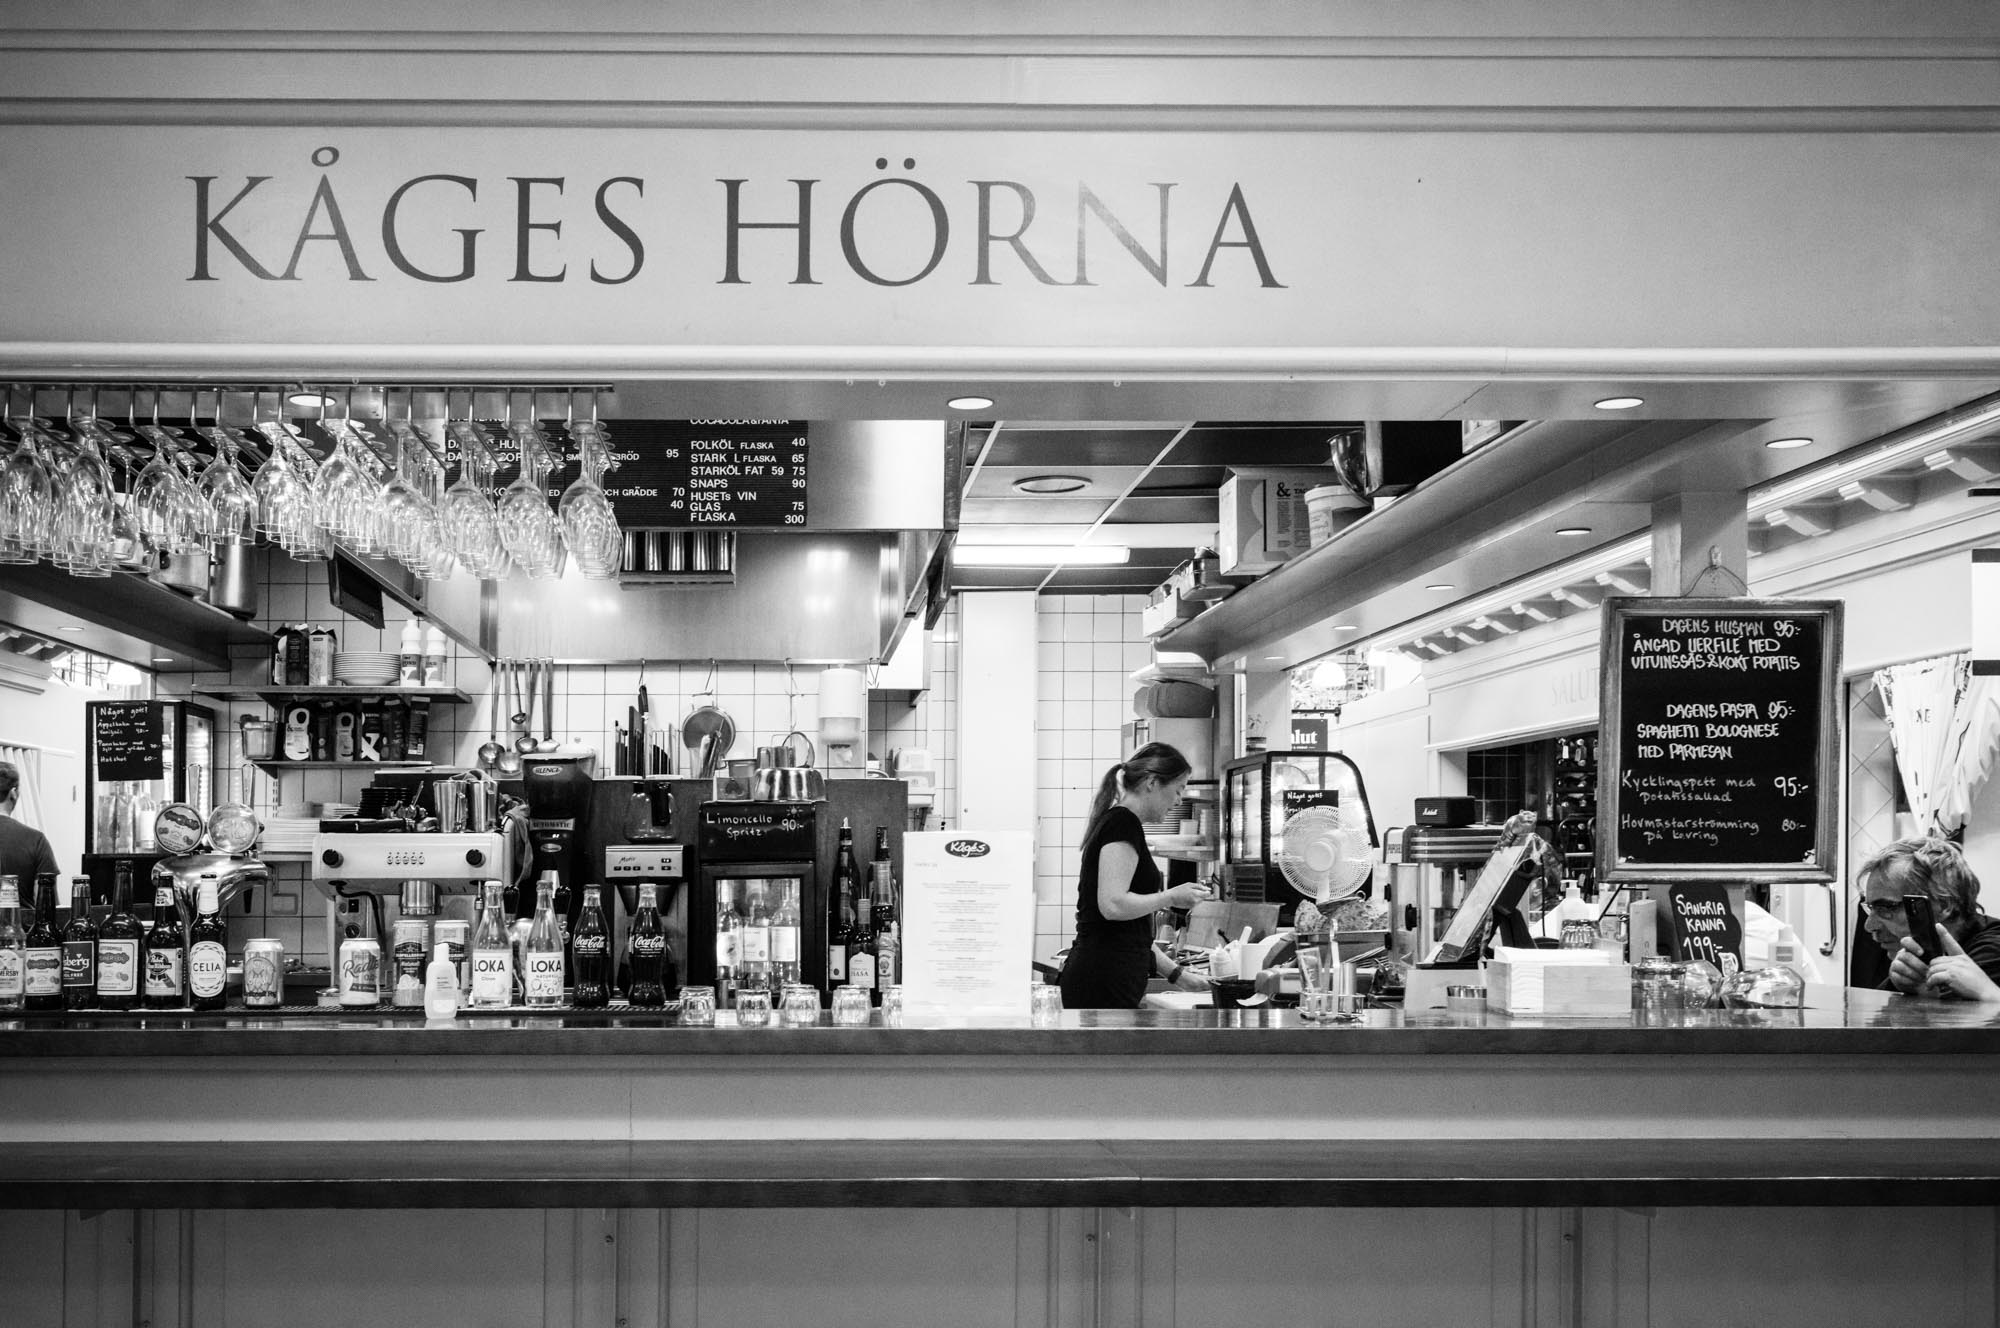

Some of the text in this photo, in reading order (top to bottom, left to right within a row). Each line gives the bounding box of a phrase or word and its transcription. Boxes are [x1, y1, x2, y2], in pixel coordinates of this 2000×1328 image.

[185, 146, 1289, 288] KÅGES HÖRNA
[690, 438, 806, 450] FOLKÖL FLASKA 40
[666, 449, 679, 458] 95
[690, 453, 727, 463] STARK
[743, 455, 777, 463] FLASKA
[791, 454, 805, 463] 65
[690, 464, 806, 476] STARKÖL FAT 59 75
[690, 479, 806, 488] SNAPS 90
[622, 486, 658, 497] GRÄDDE
[672, 487, 685, 497] 70
[690, 491, 757, 501] HUSETs VIN
[671, 500, 684, 509] 40
[690, 502, 805, 512] GLAS 75
[690, 512, 805, 524] FLASKA 300
[1662, 618, 1801, 638] DAGENS HUSMAN 95:-
[1633, 633, 1681, 653] ÅNGAD
[1749, 638, 1781, 653] MED
[1753, 656, 1801, 672] POTATIS
[1667, 700, 1796, 720] DAGENS PASTA 95:-
[1291, 729, 1319, 744] lut
[1637, 723, 1780, 739] SPAGHETTI BOLOGNESE
[1638, 743, 1733, 761] MED PARMESAN
[1621, 769, 1809, 797] Kycklingspett med 95:-
[706, 812, 773, 824] Limoncello
[726, 826, 763, 840] Spritz
[1643, 830, 1663, 845] på
[1675, 894, 1726, 916] SANGRIA
[1685, 918, 1726, 933] KANNA
[193, 962, 221, 973] CELIA
[474, 959, 506, 972] LOKA
[531, 959, 562, 973] LOKA
